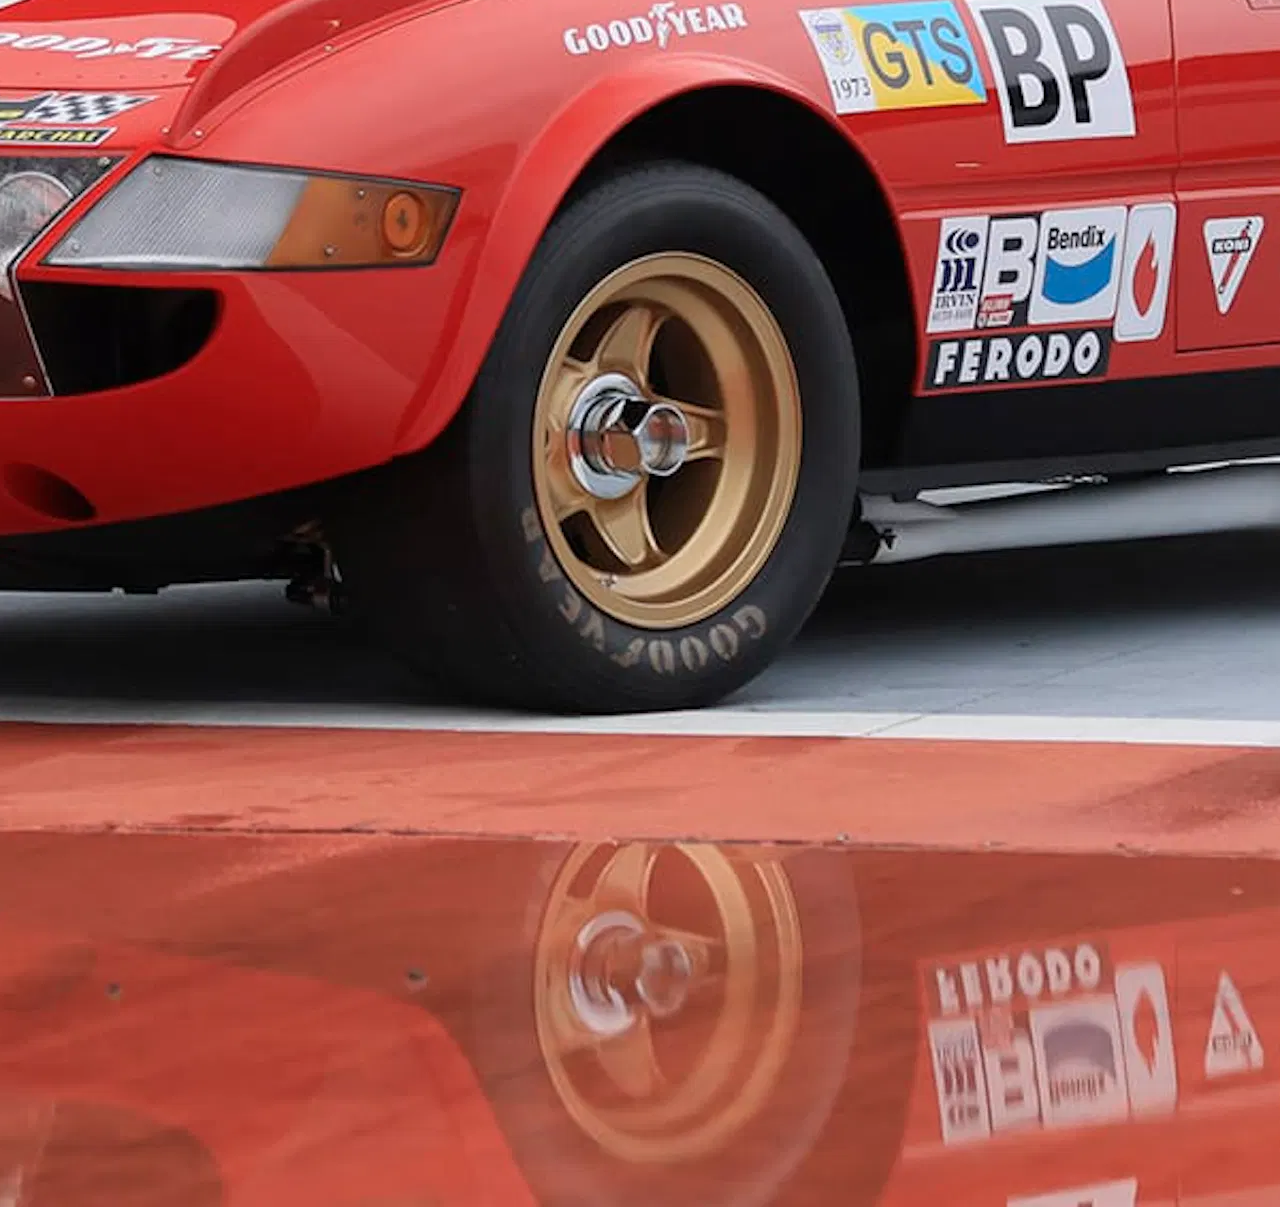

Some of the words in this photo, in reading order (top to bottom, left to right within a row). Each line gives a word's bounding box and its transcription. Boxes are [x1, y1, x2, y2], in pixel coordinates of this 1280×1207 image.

[563, 1, 748, 55] GOODYEAR
[861, 19, 974, 90] GTS
[831, 77, 871, 100] 1973
[980, 3, 1113, 128] BP
[983, 218, 1039, 303] B
[1048, 225, 1106, 251] Bendix
[1214, 239, 1249, 252] KONI
[933, 330, 1101, 386] FERODO
